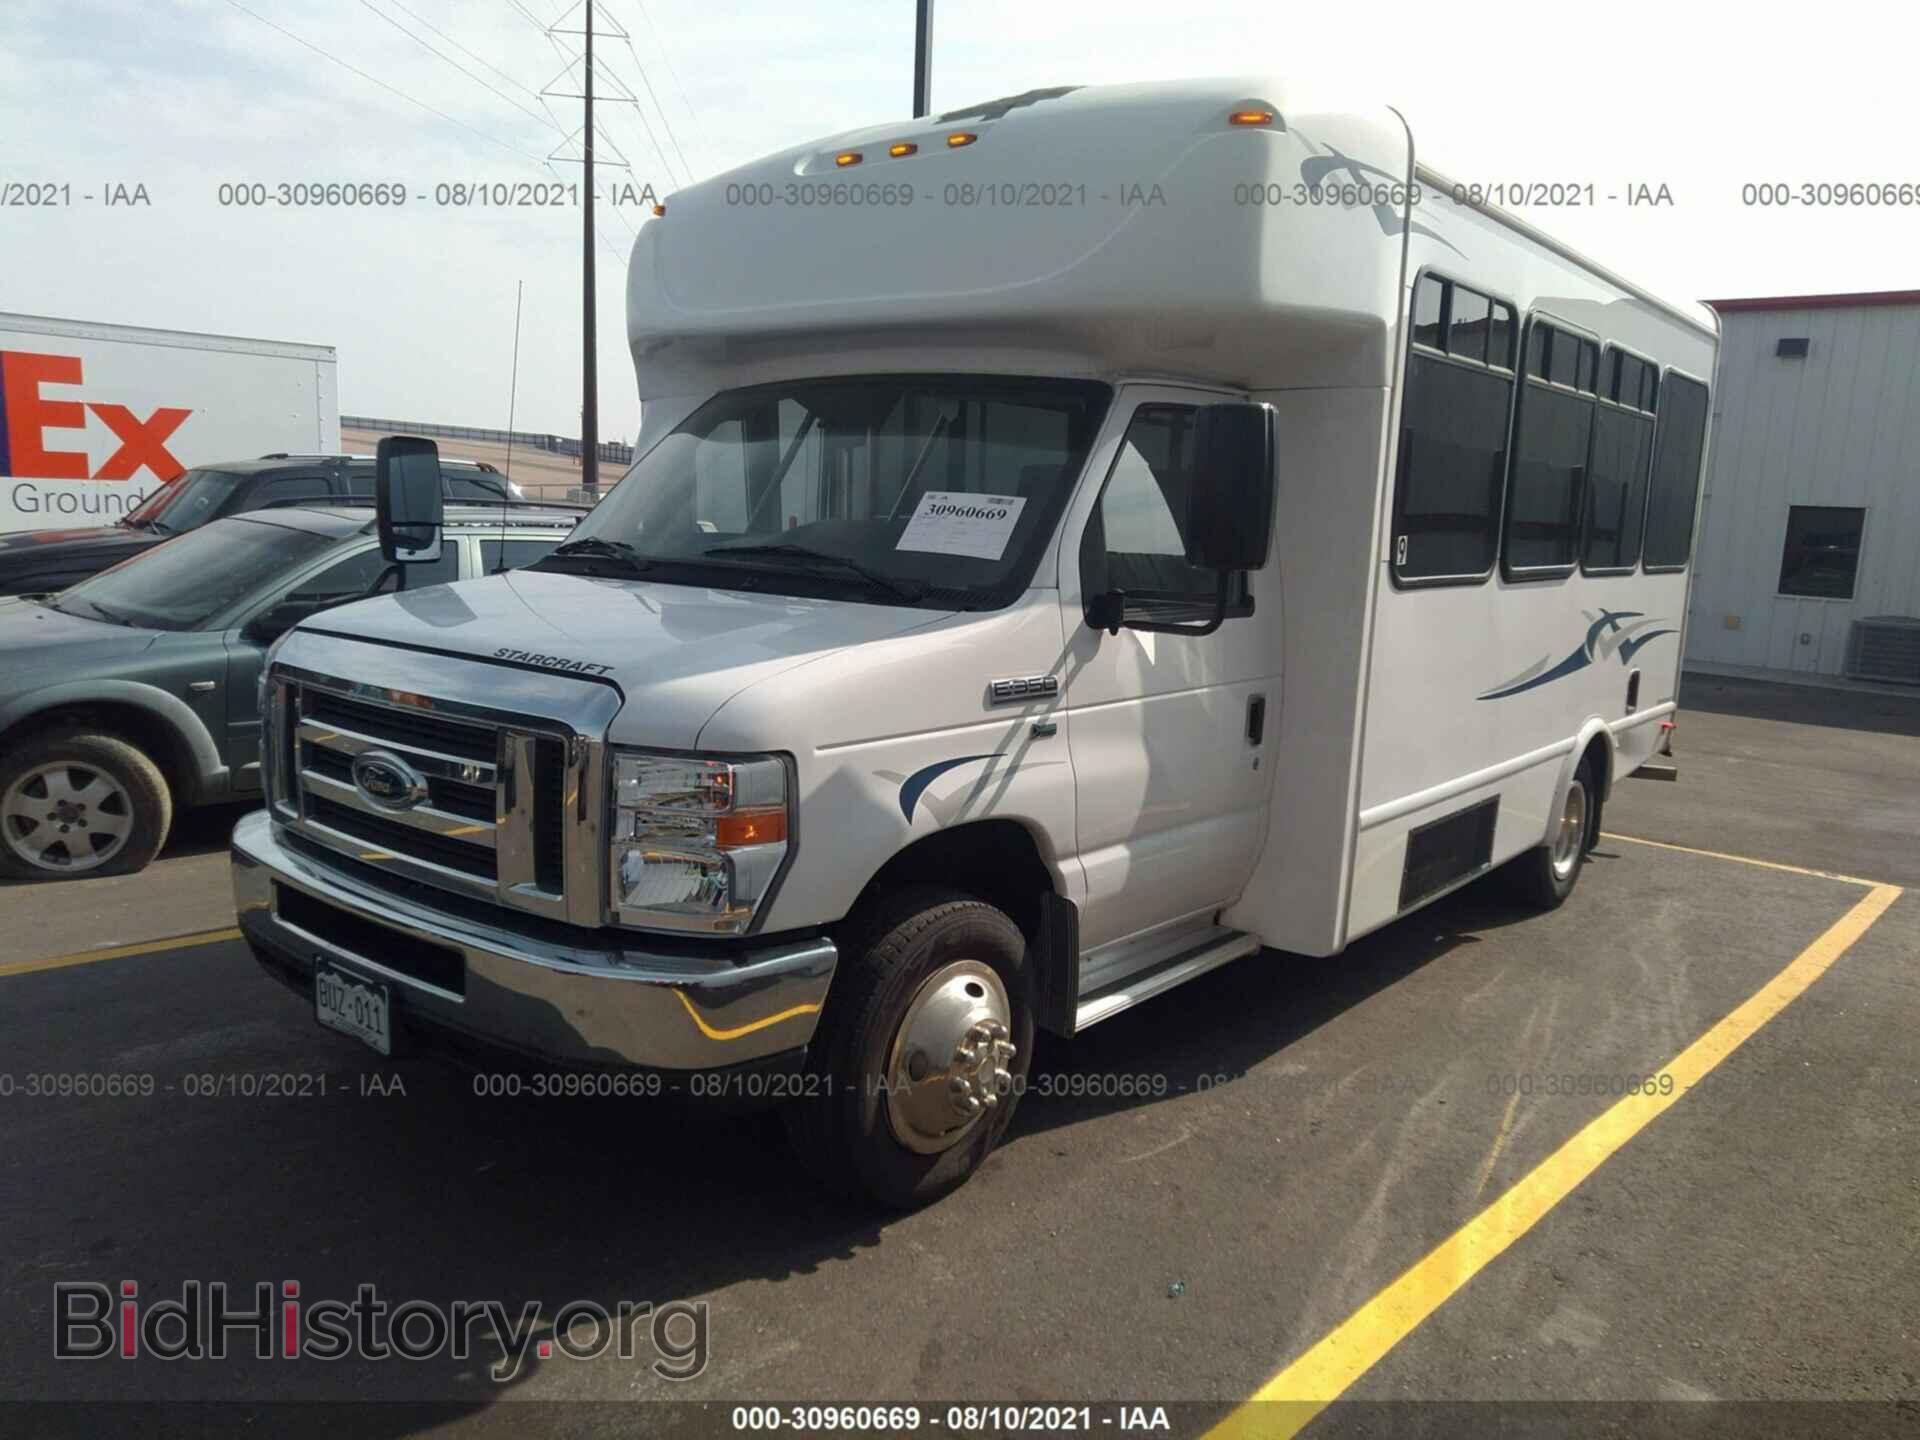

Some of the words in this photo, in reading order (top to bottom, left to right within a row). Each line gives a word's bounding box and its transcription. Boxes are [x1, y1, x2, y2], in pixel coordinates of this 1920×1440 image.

[0, 350, 192, 483] Ex
[12, 483, 144, 513] Ground
[924, 503, 1007, 520] 30960669
[493, 648, 615, 675] STARCRAFT
